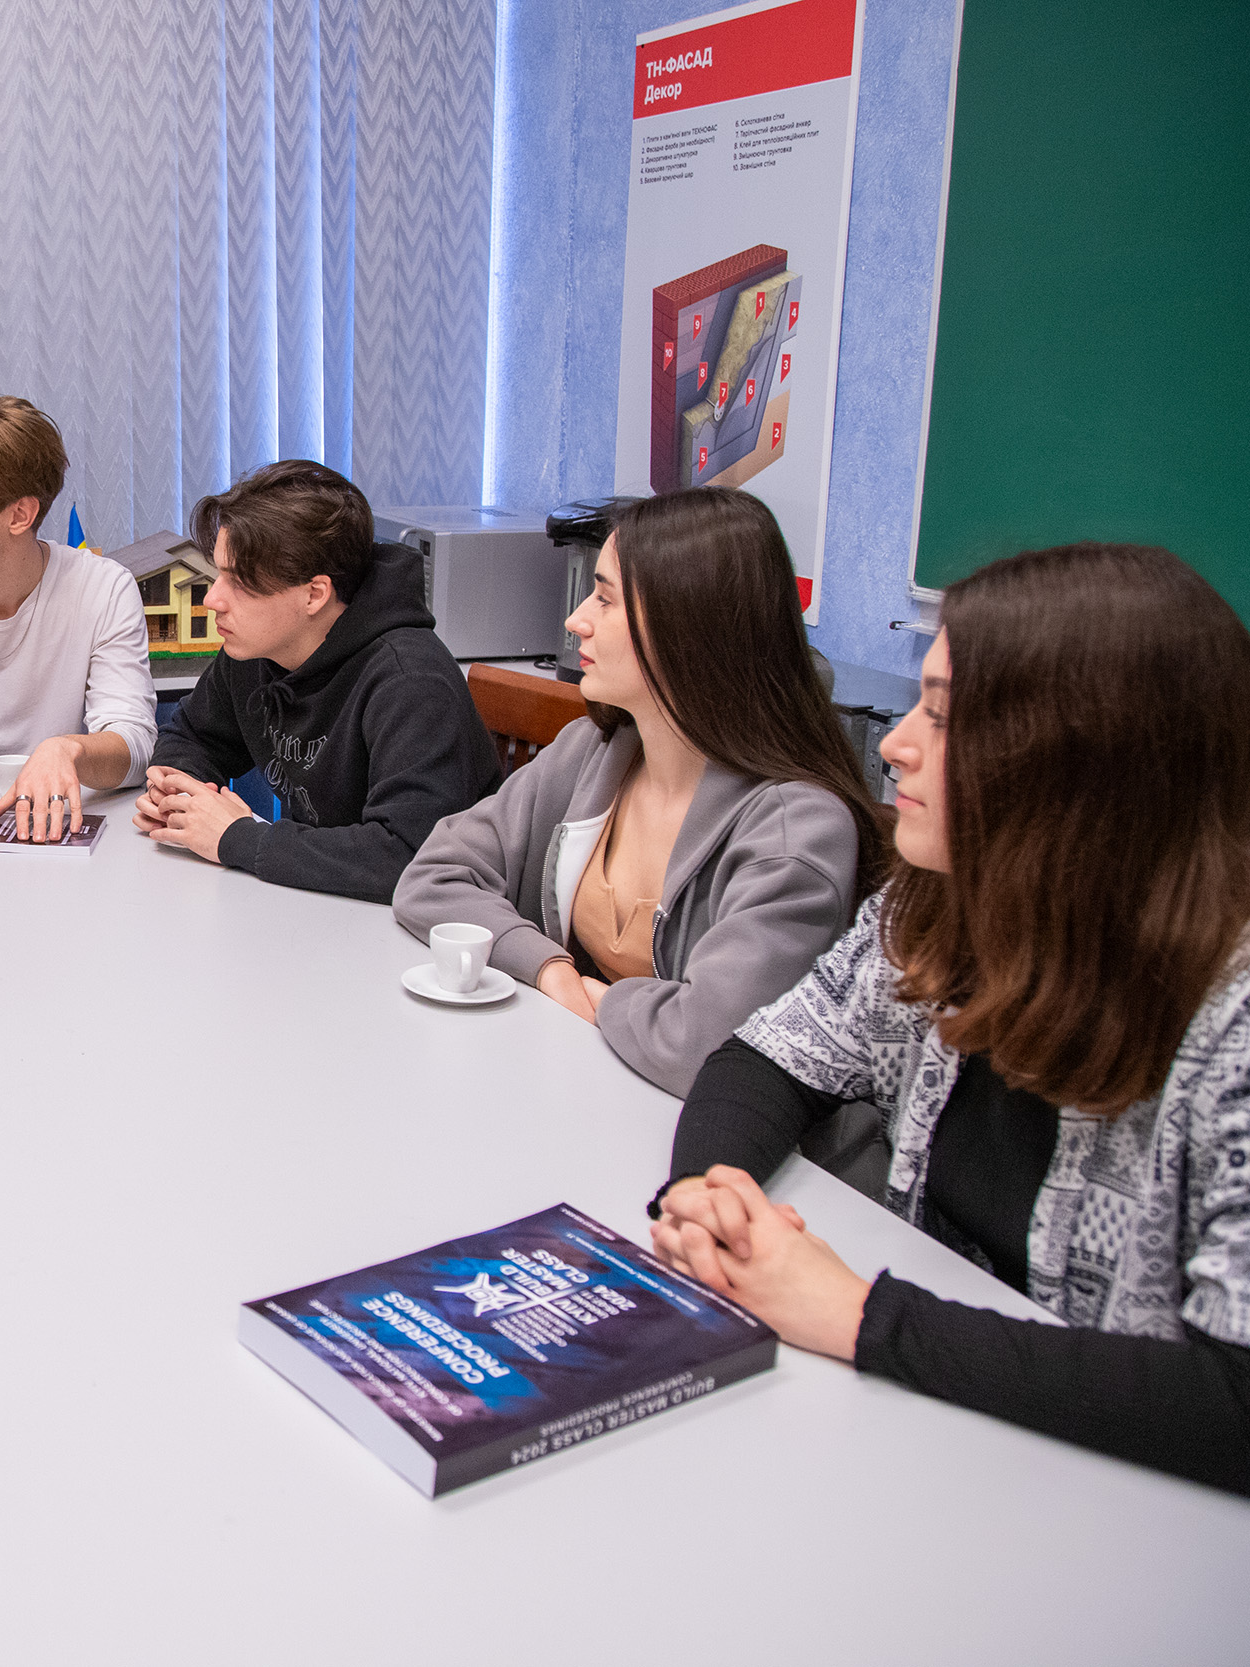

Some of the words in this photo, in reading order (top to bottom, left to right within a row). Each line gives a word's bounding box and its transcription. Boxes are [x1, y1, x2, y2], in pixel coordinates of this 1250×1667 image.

[646, 47, 712, 79] ТН-ФАСАД
[644, 82, 682, 105] Декор
[692, 124, 718, 135] ТЕХНОФАС
[758, 297, 763, 308] 1
[791, 308, 797, 318] 4
[695, 320, 700, 330] 9
[665, 348, 673, 358] 10
[699, 367, 706, 378] 8
[783, 360, 789, 370] 3
[720, 387, 726, 397] 7
[747, 385, 753, 395] 6
[774, 428, 780, 439] 2
[700, 452, 706, 462] 5
[502, 1249, 571, 1289] MASTER
[532, 1250, 589, 1283] CLASS
[500, 1265, 552, 1296] BUILD
[594, 1285, 636, 1310] 2024
[554, 1299, 597, 1324] KYIV
[363, 1300, 483, 1383] CONFERENCE
[385, 1292, 508, 1377] PROCEEDINGS
[672, 1377, 715, 1403] BUILD
[608, 1396, 667, 1428] MASTER
[552, 1420, 603, 1449] CLASS
[511, 1440, 547, 1464] 2024
